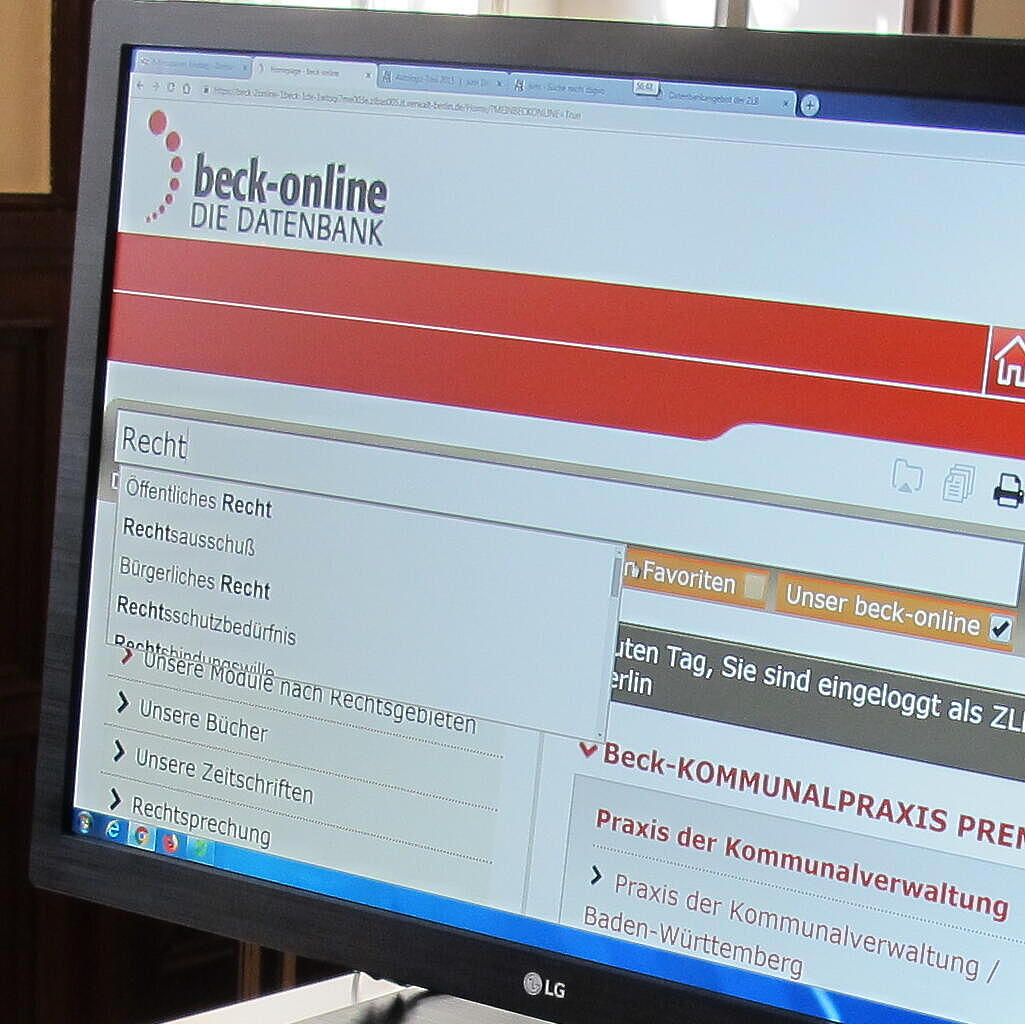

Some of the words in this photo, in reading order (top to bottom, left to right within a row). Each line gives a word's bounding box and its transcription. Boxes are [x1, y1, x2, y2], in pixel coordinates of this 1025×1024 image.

[194, 152, 388, 214] beck-online
[190, 202, 229, 231] DIE
[237, 206, 384, 247] DATENBANK
[122, 426, 187, 460] Recht
[126, 475, 217, 509] Öffentliches
[222, 493, 273, 519] Recht
[123, 517, 255, 557] Rechtsausschuß
[120, 556, 215, 590] Bürgerliches
[220, 574, 271, 600] Recht
[642, 560, 737, 595] Favoriten
[117, 595, 296, 647] Rechtsschutzbedürfnis
[786, 584, 848, 613] Unser
[854, 591, 981, 637] beck-online
[144, 652, 204, 680] Unsere
[210, 664, 275, 693] Module
[280, 678, 324, 704] nach
[331, 689, 478, 736] Rechtsgebieten
[667, 645, 714, 680] Tag,
[722, 655, 757, 683] Sie
[763, 664, 811, 693] sind
[818, 677, 942, 719] eingeloggt
[948, 698, 984, 725] als
[990, 704, 1025, 734] ZL
[139, 698, 201, 728] Unsere
[206, 713, 270, 743] Bücher
[135, 747, 196, 778] Unsere
[202, 762, 315, 805] Zeitschriften
[603, 741, 948, 834] Beck-KOMMUNALPRAXIS
[132, 796, 272, 850] Rechtsprechung
[596, 808, 670, 842] Praxis
[677, 826, 717, 853] der
[724, 836, 1010, 923] Kommunalverwaltung
[583, 905, 805, 981] Baden-Württemberg
[614, 873, 678, 906] Praxis
[686, 889, 722, 917] der
[729, 899, 980, 982] Kommunalverwaltung
[544, 979, 566, 999] LG
